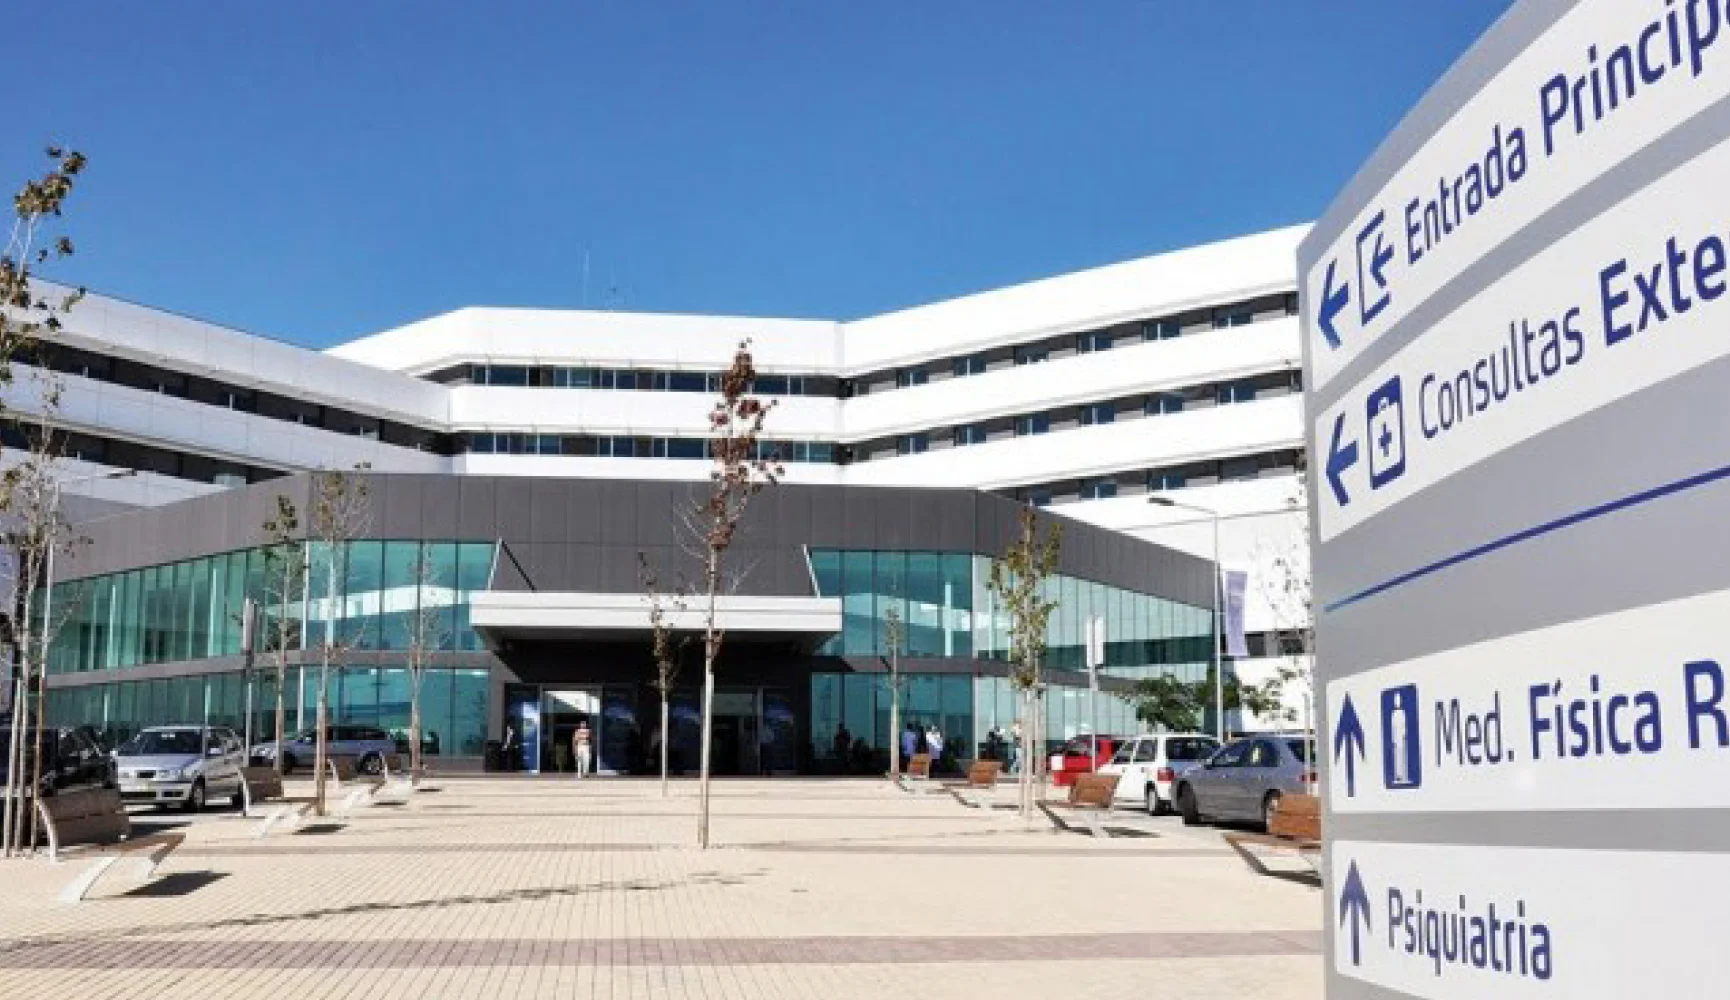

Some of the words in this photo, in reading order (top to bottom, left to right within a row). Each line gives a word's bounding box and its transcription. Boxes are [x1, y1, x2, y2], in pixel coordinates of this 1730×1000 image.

[1404, 123, 1527, 266] Entrada
[1540, 0, 1730, 156] Princip
[1419, 306, 1585, 440] Consultas
[1599, 235, 1730, 347] Exte
[1434, 690, 1515, 766] Med.
[1529, 674, 1663, 760] Física
[1683, 660, 1730, 749] R
[1388, 887, 1553, 980] Psiquiatria
